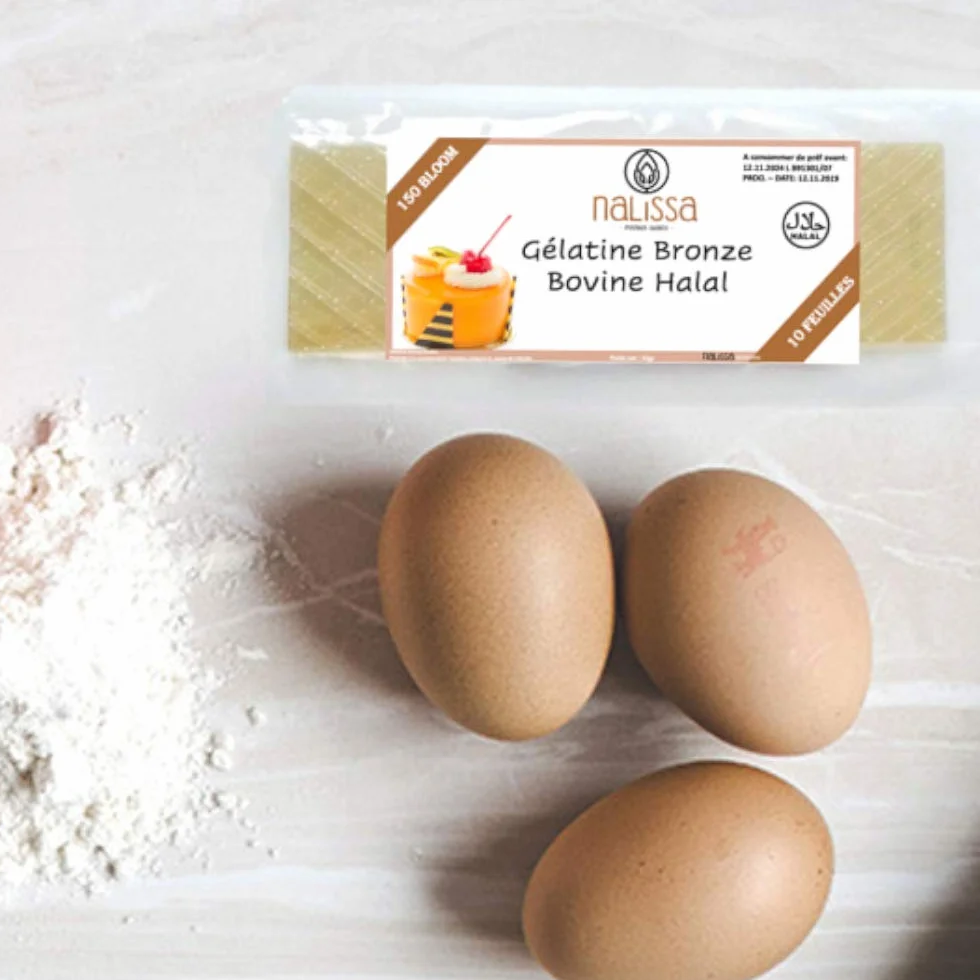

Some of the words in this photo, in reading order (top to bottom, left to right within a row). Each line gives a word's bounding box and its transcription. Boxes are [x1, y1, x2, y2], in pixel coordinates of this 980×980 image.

[396, 185, 422, 211] 150
[417, 145, 459, 190] BLOOM
[790, 232, 821, 240] HALAL
[521, 237, 643, 262] Gélatine
[653, 240, 753, 261] Bronze
[547, 270, 644, 292] Bovine
[655, 270, 729, 292] Halal
[787, 329, 806, 348] 10
[801, 275, 855, 333] FEUILLES
